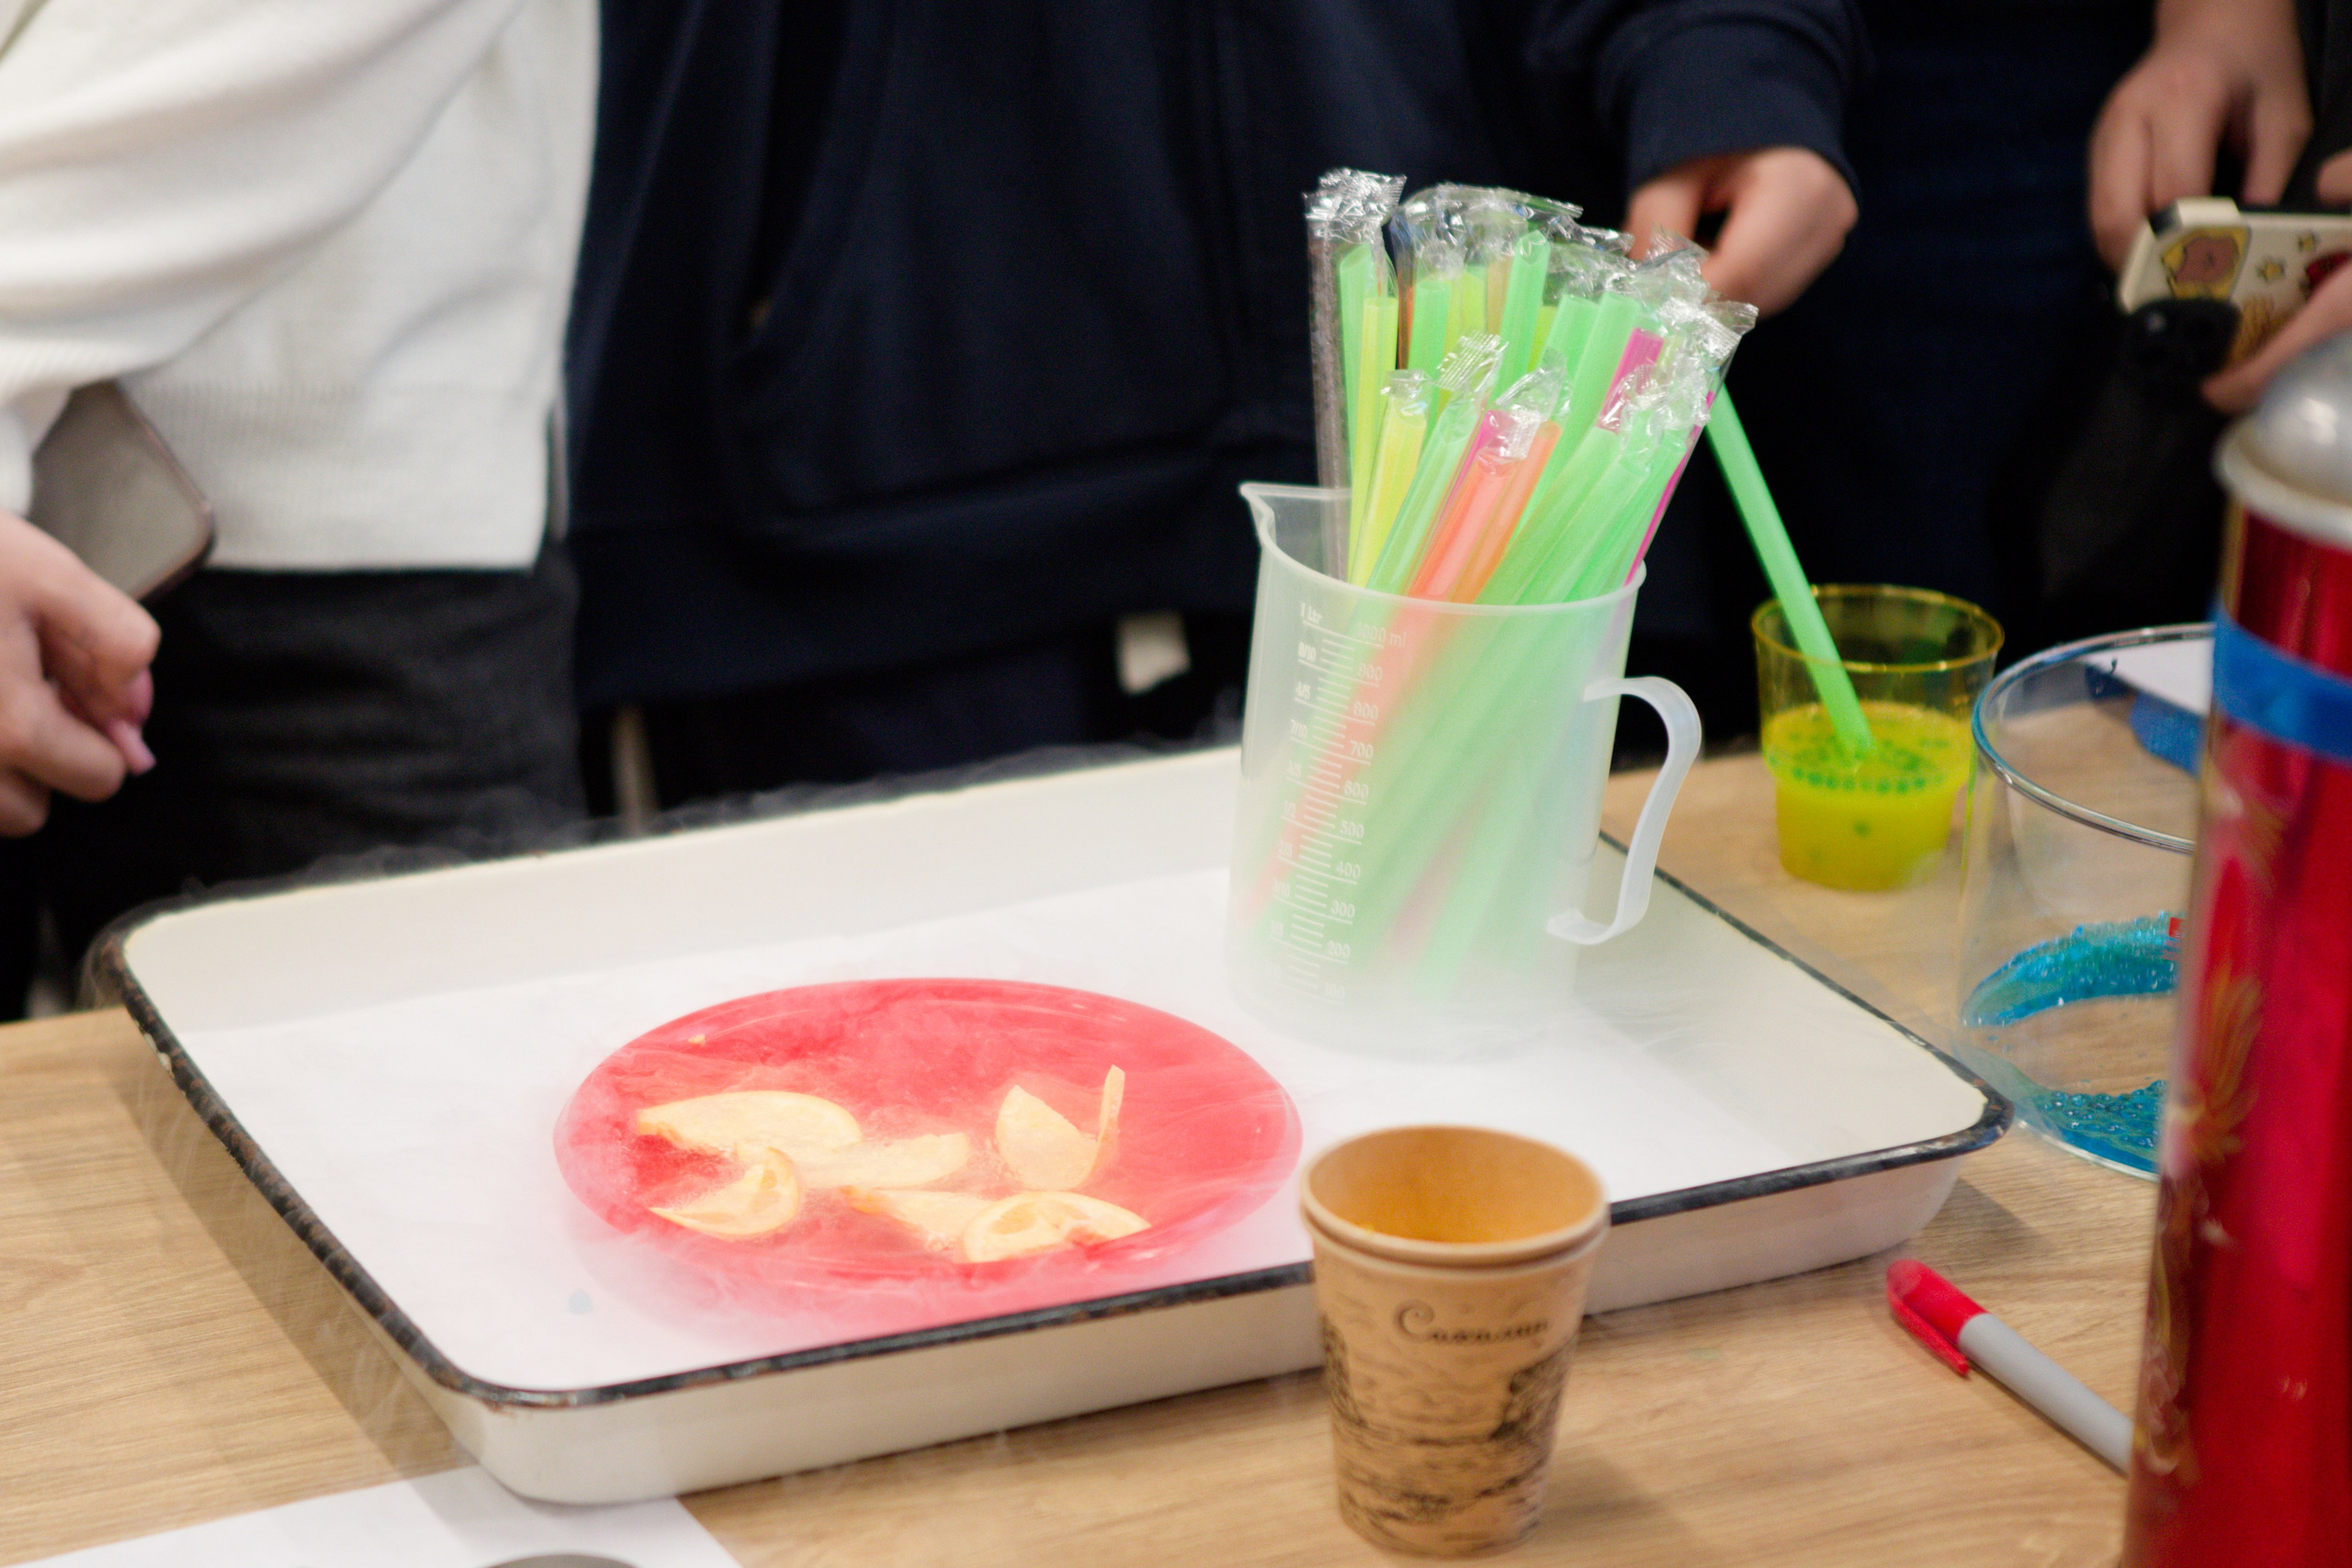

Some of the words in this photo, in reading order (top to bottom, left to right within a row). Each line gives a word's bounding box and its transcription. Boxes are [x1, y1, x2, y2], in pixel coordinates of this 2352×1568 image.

[1390, 634, 1407, 648] ml
[1358, 664, 1384, 682] 900
[1353, 703, 1379, 720] 800
[1351, 741, 1374, 760] 700
[1344, 782, 1369, 799] 600
[1340, 821, 1365, 840] 500
[1337, 863, 1362, 880] 400
[1331, 901, 1356, 919] 300
[1328, 941, 1351, 959] 200
[1324, 983, 1346, 1000] 100
